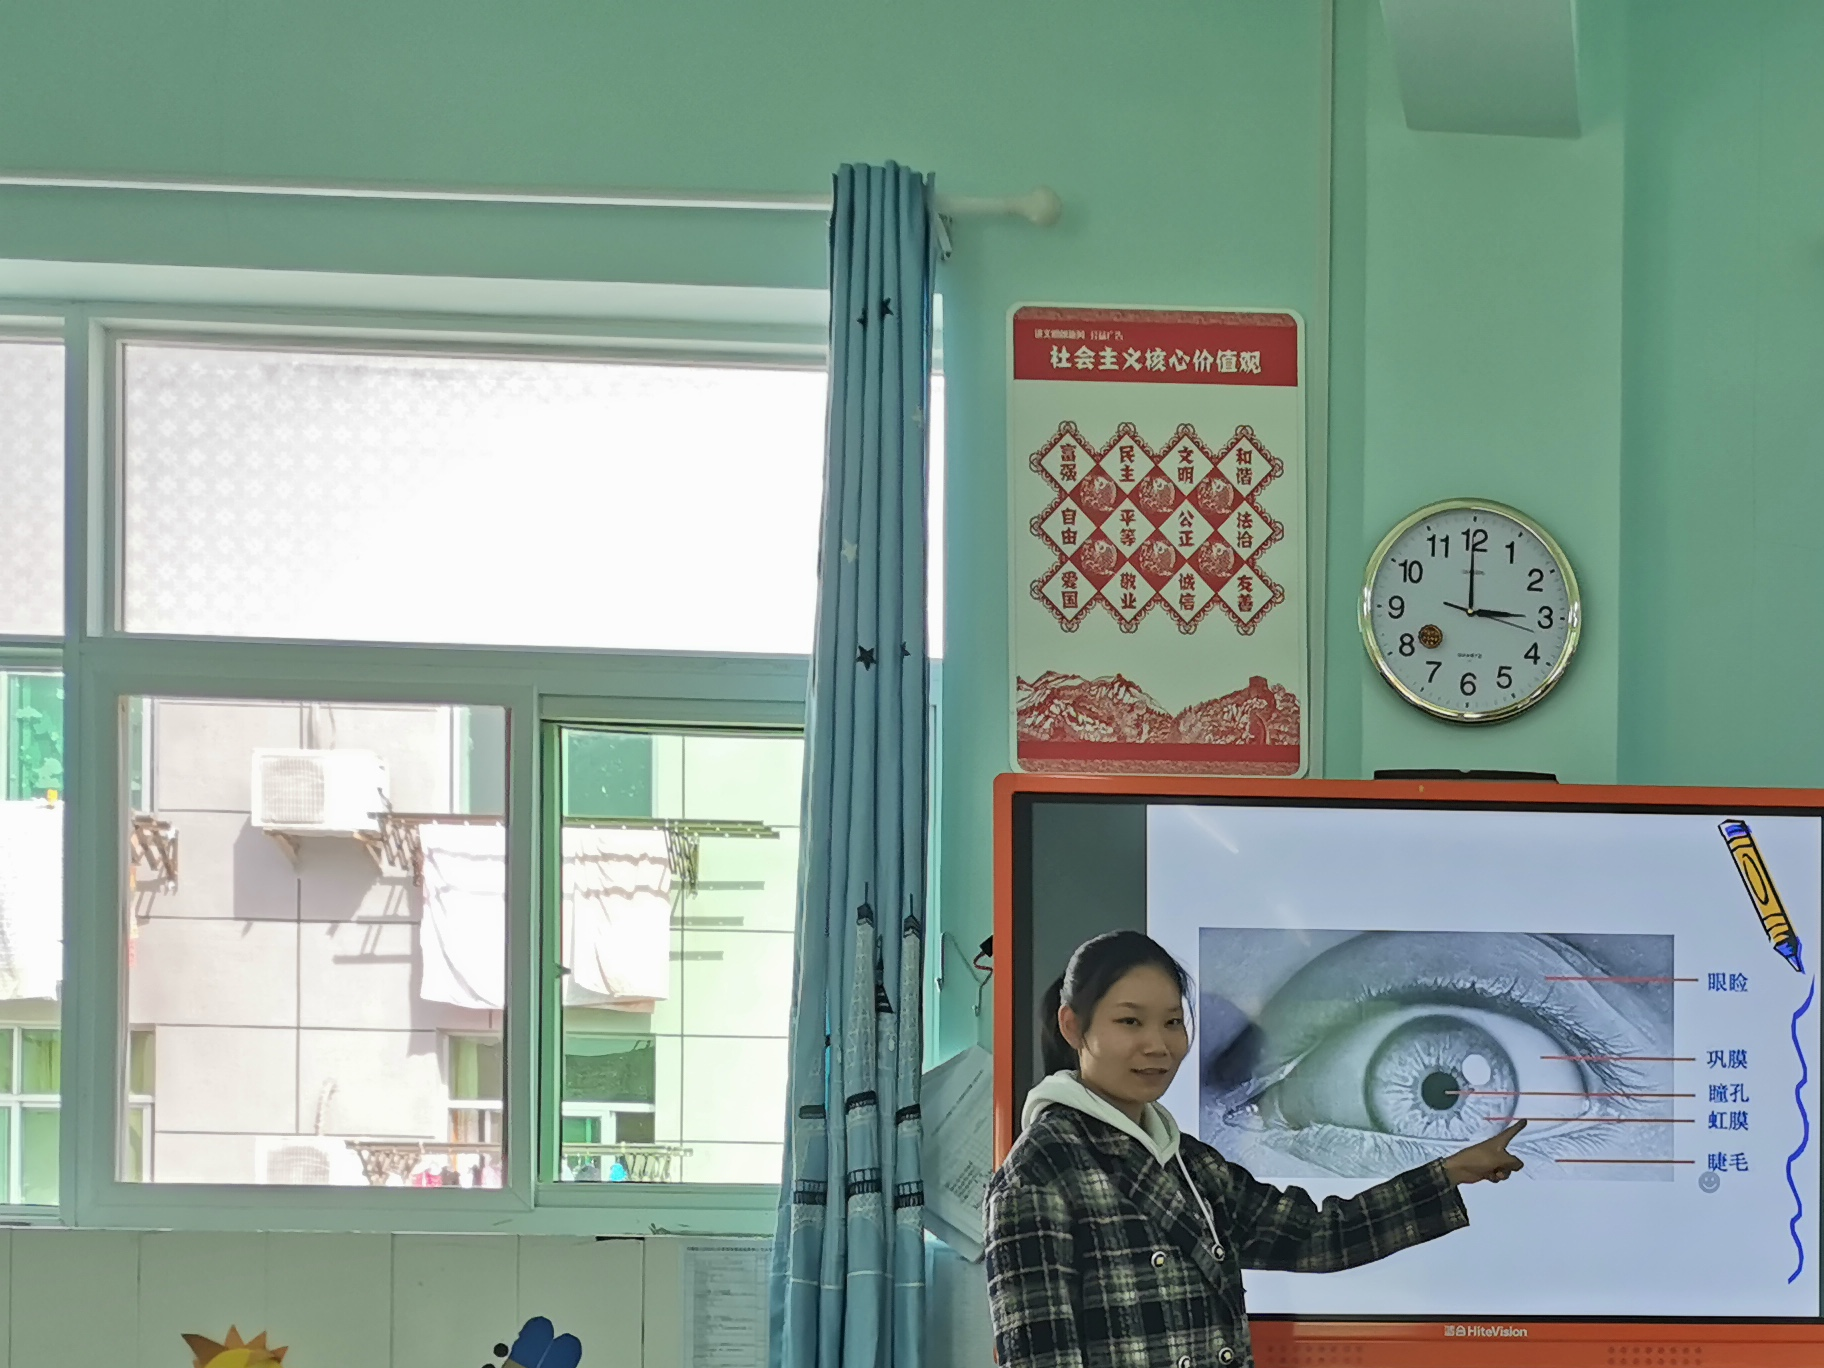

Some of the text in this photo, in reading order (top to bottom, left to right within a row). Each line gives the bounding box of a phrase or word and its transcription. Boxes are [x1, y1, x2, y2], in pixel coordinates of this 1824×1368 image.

[1050, 344, 1262, 374] 社会主义核心价值观
[1060, 444, 1077, 482] 富强
[1119, 445, 1135, 482] 民主
[1177, 446, 1194, 484] 文明
[1236, 448, 1252, 485] 和谐
[1061, 508, 1077, 546] 自由
[1119, 509, 1136, 546] 平等
[1178, 510, 1195, 547] 公正
[1237, 511, 1253, 548] 法治
[1427, 534, 1449, 558] 11
[1461, 528, 1488, 552] 12
[1505, 541, 1515, 564] 1
[1398, 559, 1423, 584] 10
[1527, 568, 1544, 592] 2
[1061, 571, 1078, 609] 爱国
[1120, 572, 1136, 610] 敬业
[1178, 573, 1195, 611] 诚信
[1237, 575, 1253, 612] 友善
[1388, 595, 1404, 619] 9
[1537, 606, 1553, 629] 3
[1399, 633, 1415, 657] 8
[1524, 642, 1540, 665] 4
[1426, 661, 1442, 683] 7
[1460, 672, 1476, 696] 6
[1496, 666, 1512, 689] 5
[1707, 972, 1748, 993] 眼睑
[1706, 1049, 1747, 1069] 巩膜
[1708, 1083, 1749, 1103] 瞳孔
[1708, 1110, 1749, 1131] 虹膜
[1708, 1151, 1749, 1172] 睫毛
[1467, 1326, 1528, 1338] HiteVision
